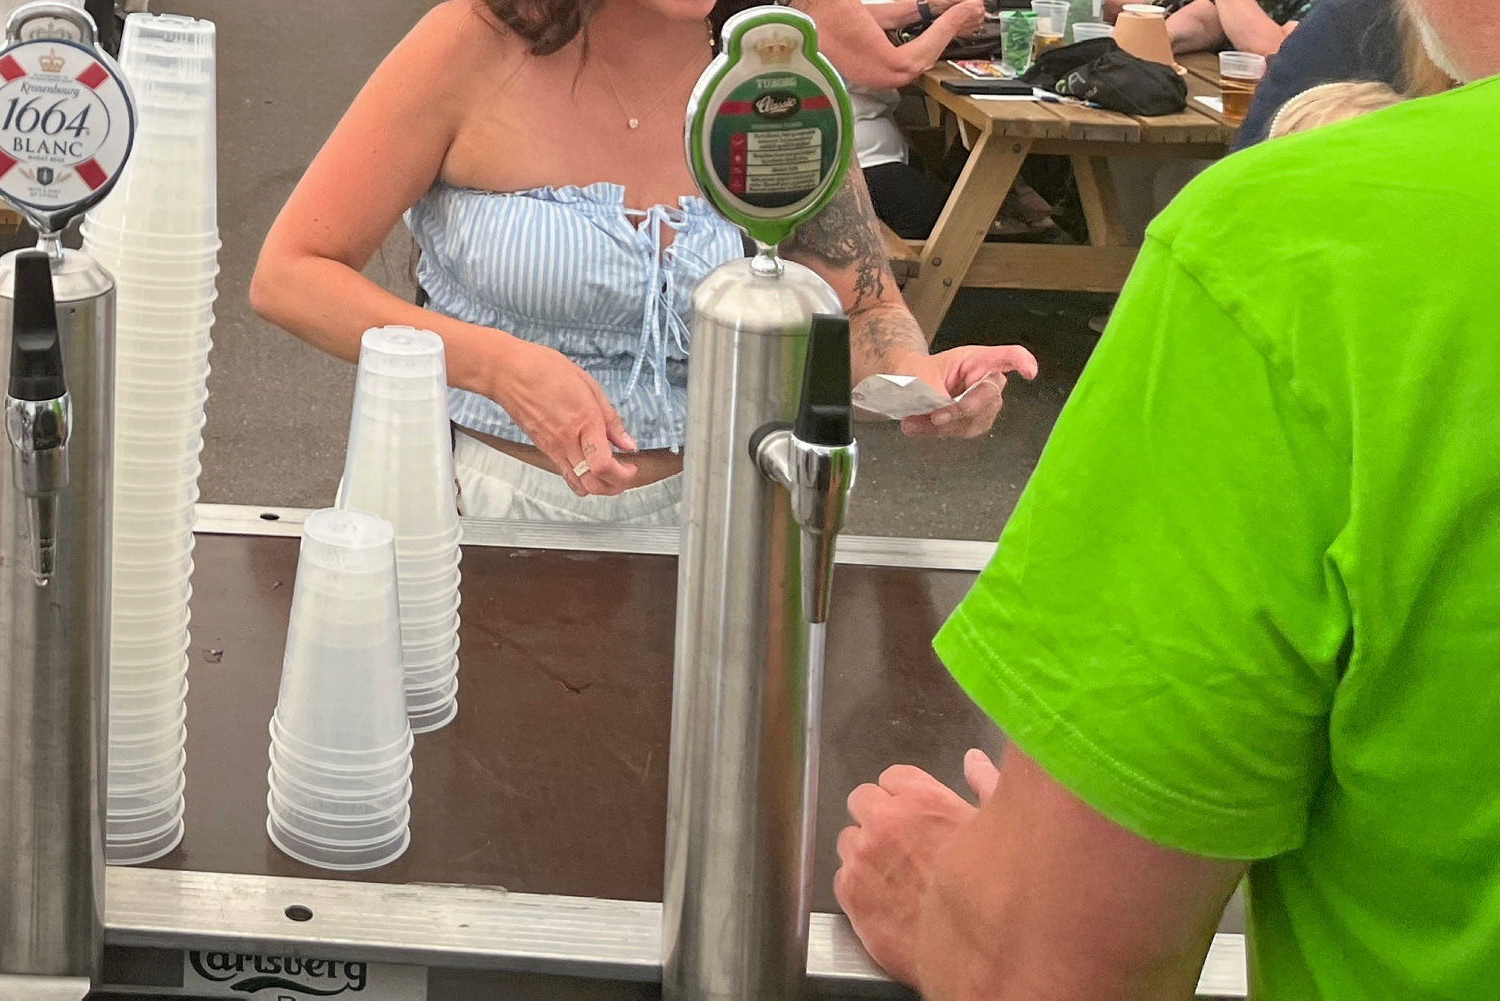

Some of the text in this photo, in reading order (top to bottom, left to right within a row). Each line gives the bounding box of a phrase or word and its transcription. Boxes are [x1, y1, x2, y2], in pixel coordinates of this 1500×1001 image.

[20, 81, 80, 98] Kronenbourg
[2, 95, 91, 138] 1664
[13, 136, 83, 157] BLANC
[189, 950, 368, 991] Carlsberg
